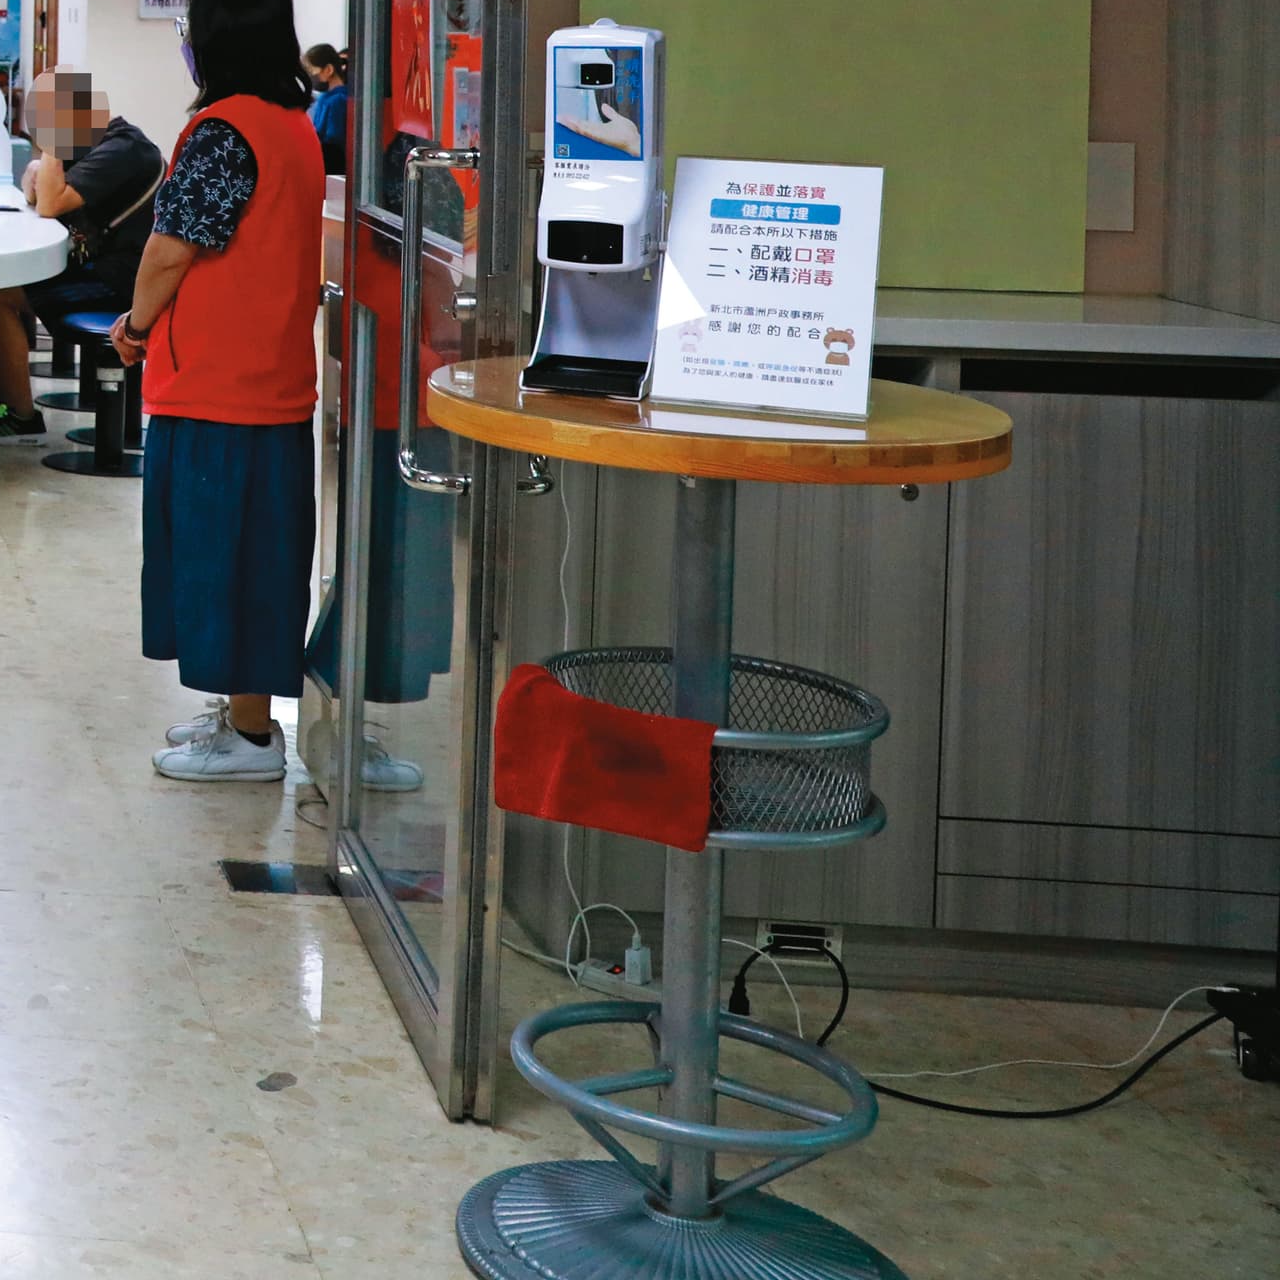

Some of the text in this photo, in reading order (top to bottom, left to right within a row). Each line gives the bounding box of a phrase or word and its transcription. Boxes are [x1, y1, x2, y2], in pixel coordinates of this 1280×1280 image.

[726, 182, 826, 200] 為保護並落實
[741, 204, 809, 221] 健康管理
[710, 223, 838, 241] 請配合本所以下措施
[709, 244, 835, 265] 一、配戴口罩
[707, 264, 833, 287] 二、酒精消毒
